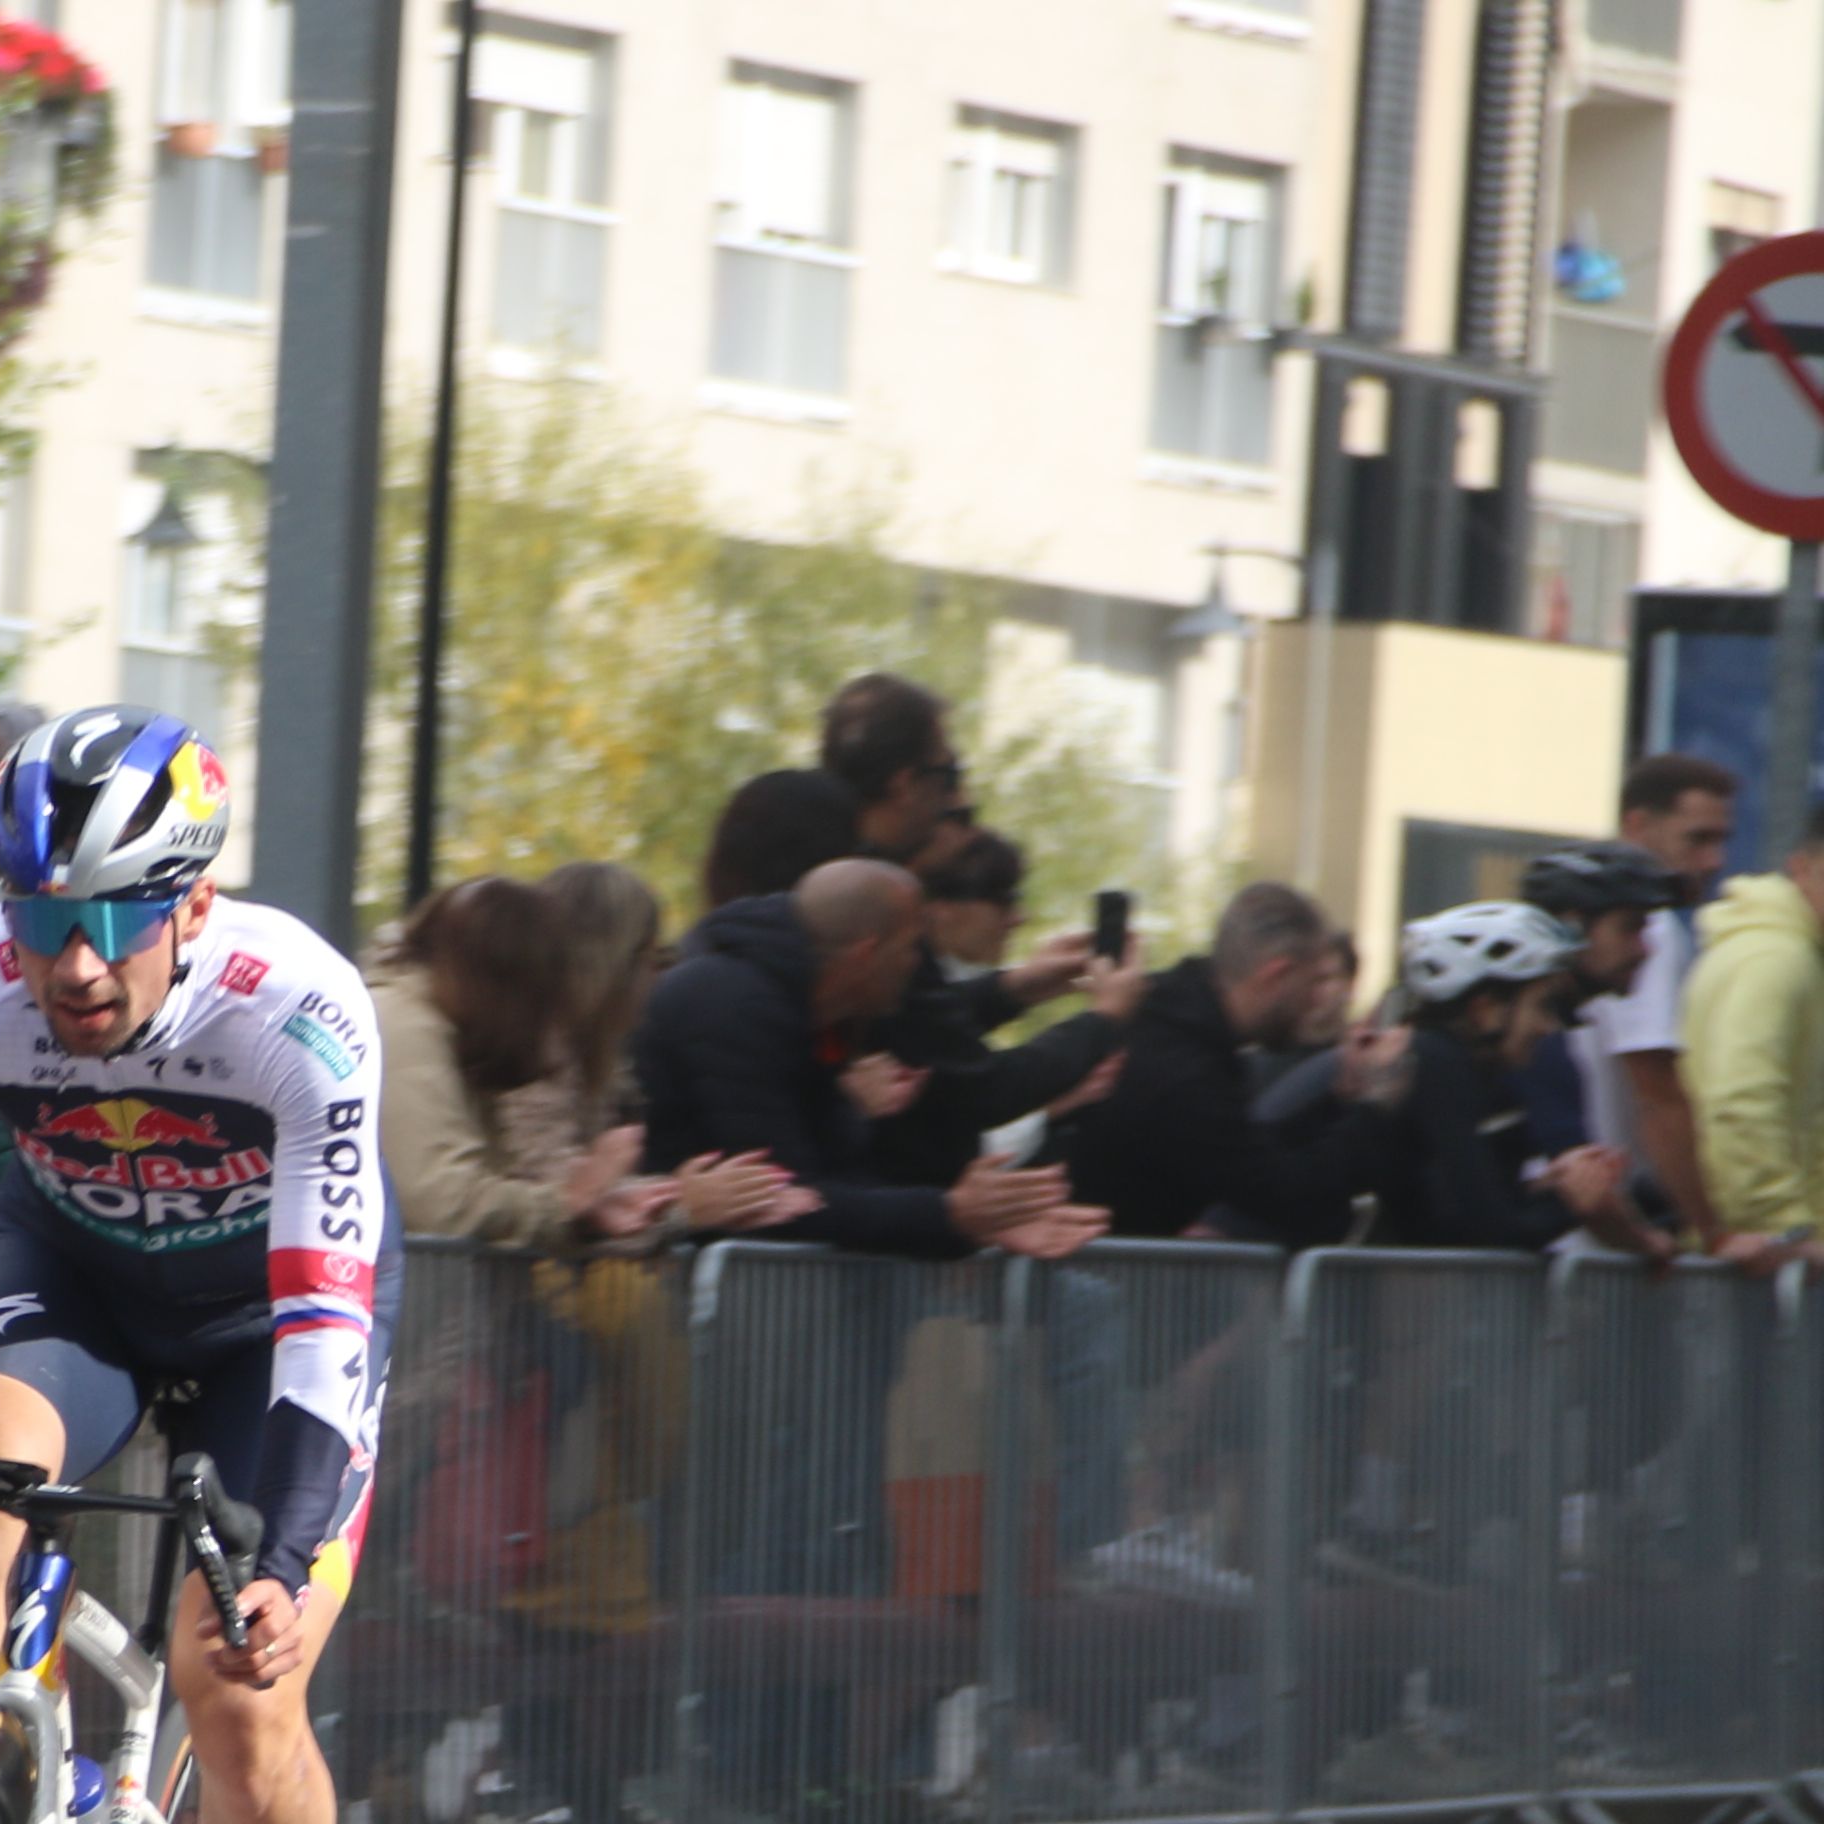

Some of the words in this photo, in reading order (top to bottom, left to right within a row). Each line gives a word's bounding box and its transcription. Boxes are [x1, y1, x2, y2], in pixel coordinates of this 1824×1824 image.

[299, 989, 368, 1065] BORA
[14, 1127, 133, 1188] Red
[136, 1145, 273, 1191] Bull
[319, 1098, 364, 1245] BOSS
